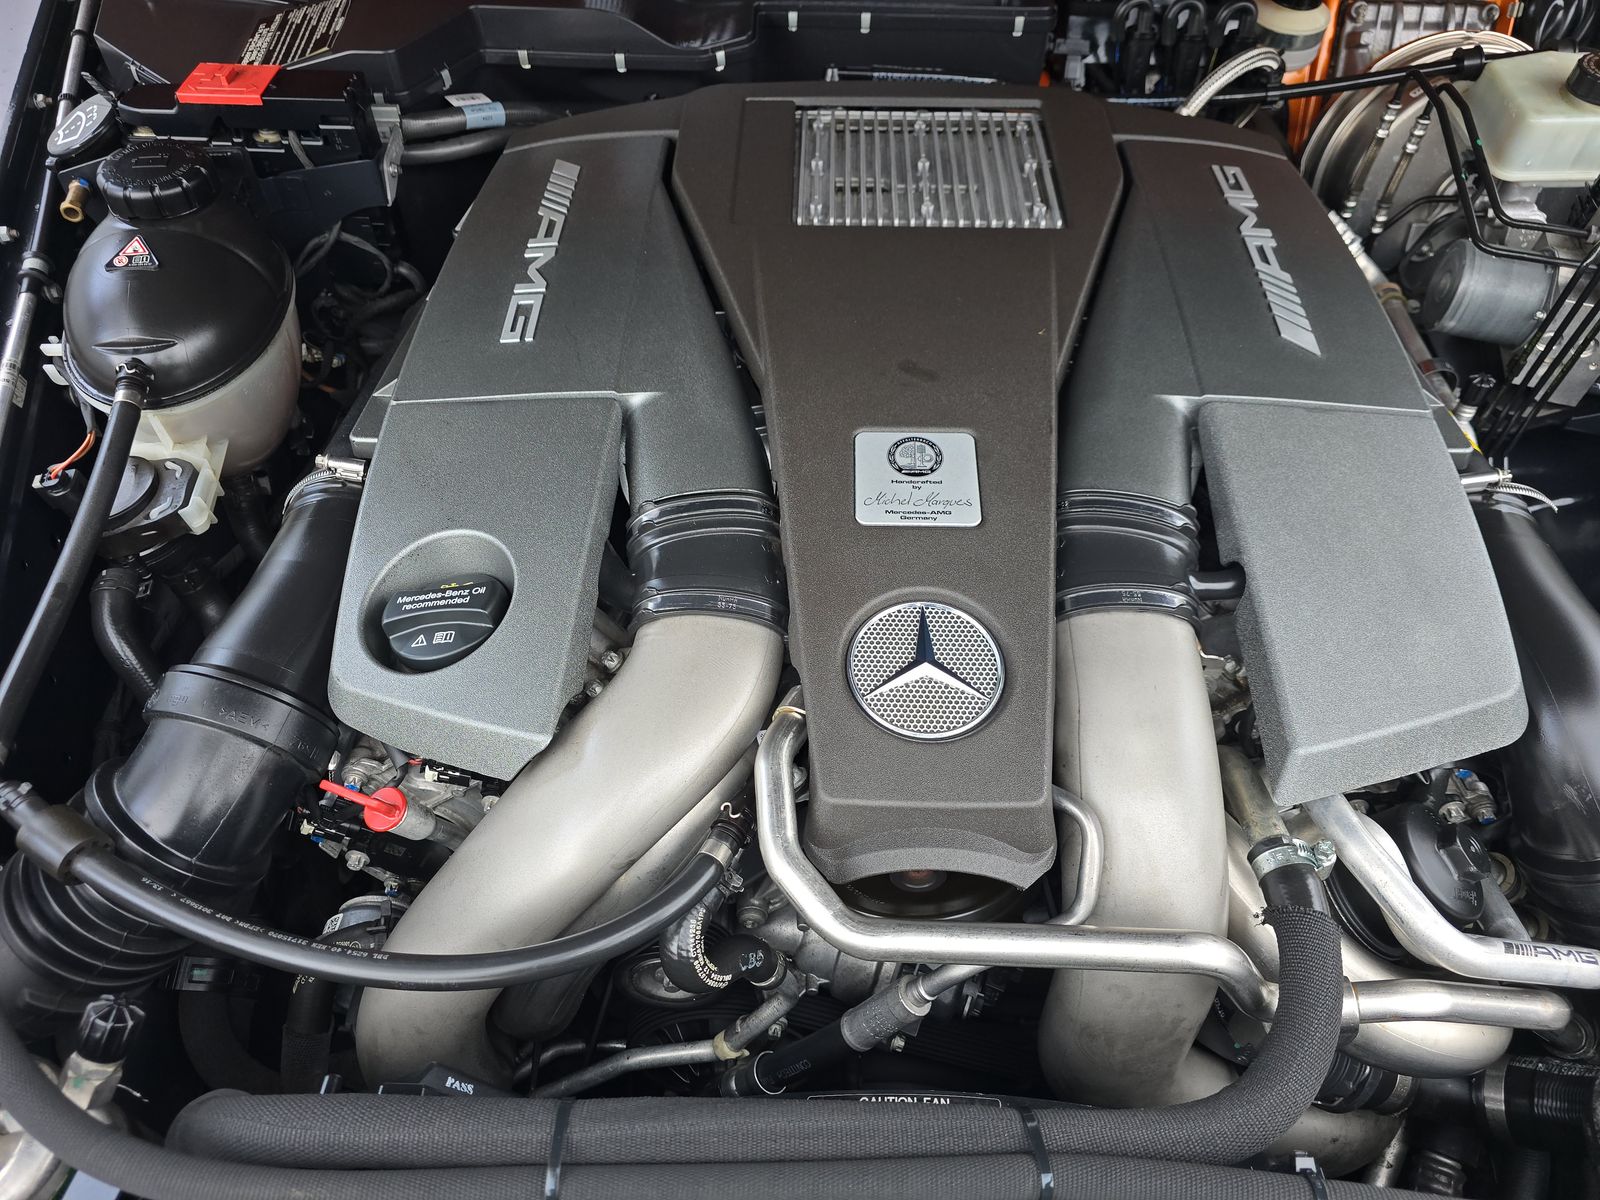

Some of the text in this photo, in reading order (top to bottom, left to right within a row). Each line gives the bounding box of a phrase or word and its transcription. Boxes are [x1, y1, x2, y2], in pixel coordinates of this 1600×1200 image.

[500, 206, 567, 343] AMG
[396, 586, 486, 604] Mercedes-Benz Oil
[401, 596, 471, 611] recommended
[1533, 945, 1599, 965] AMG
[445, 1076, 474, 1095] PASS
